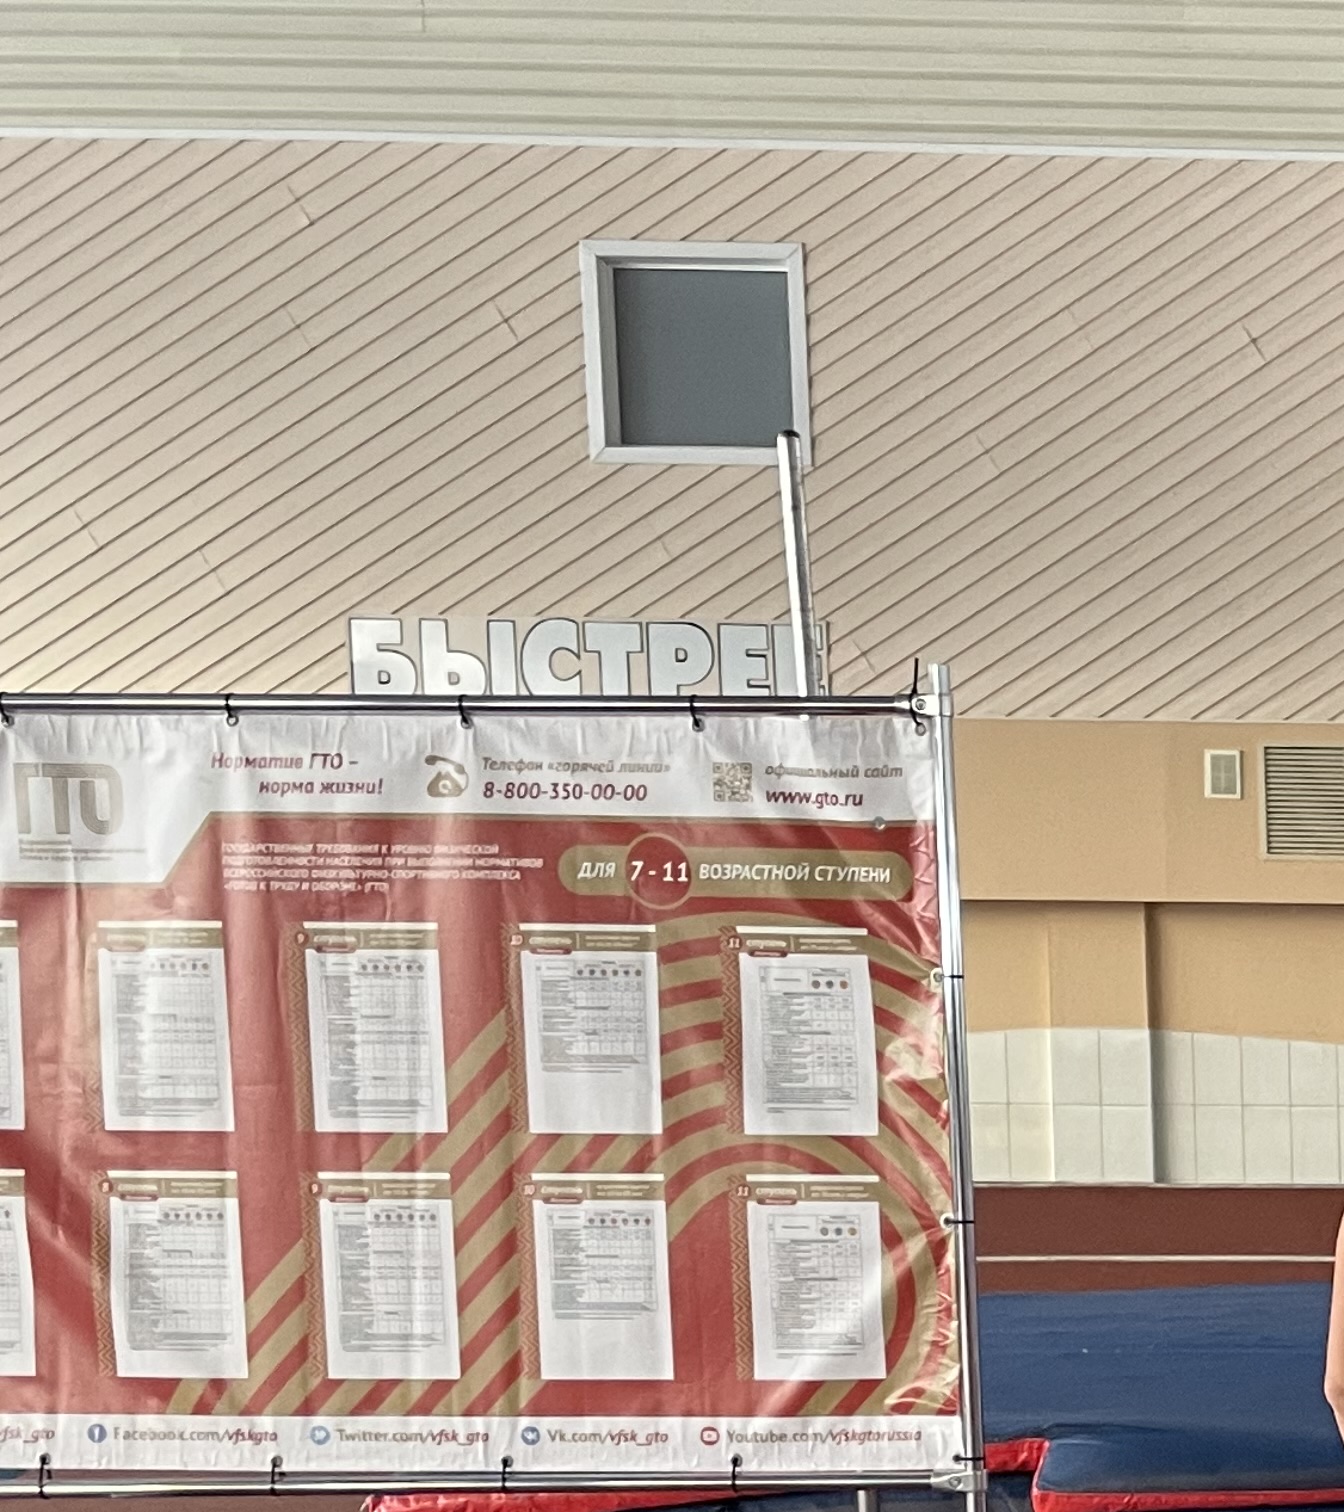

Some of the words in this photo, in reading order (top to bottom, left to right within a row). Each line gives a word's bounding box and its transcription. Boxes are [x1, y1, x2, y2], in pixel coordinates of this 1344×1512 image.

[308, 753, 344, 770] ГТО
[259, 780, 314, 797] норма
[319, 778, 384, 795] жизни!
[483, 781, 648, 801] 8-800-350-00-00
[13, 762, 124, 835] ГТО
[765, 788, 864, 808] www.gto.ru
[577, 862, 616, 879] ДЛЯ
[630, 862, 644, 881] 7
[662, 862, 688, 882] 11
[699, 862, 809, 881] ВОЗРАСТНОЙ
[814, 864, 891, 883] СТУПЕНИ
[547, 1429, 669, 1447] Vk.com/vfsk_gto
